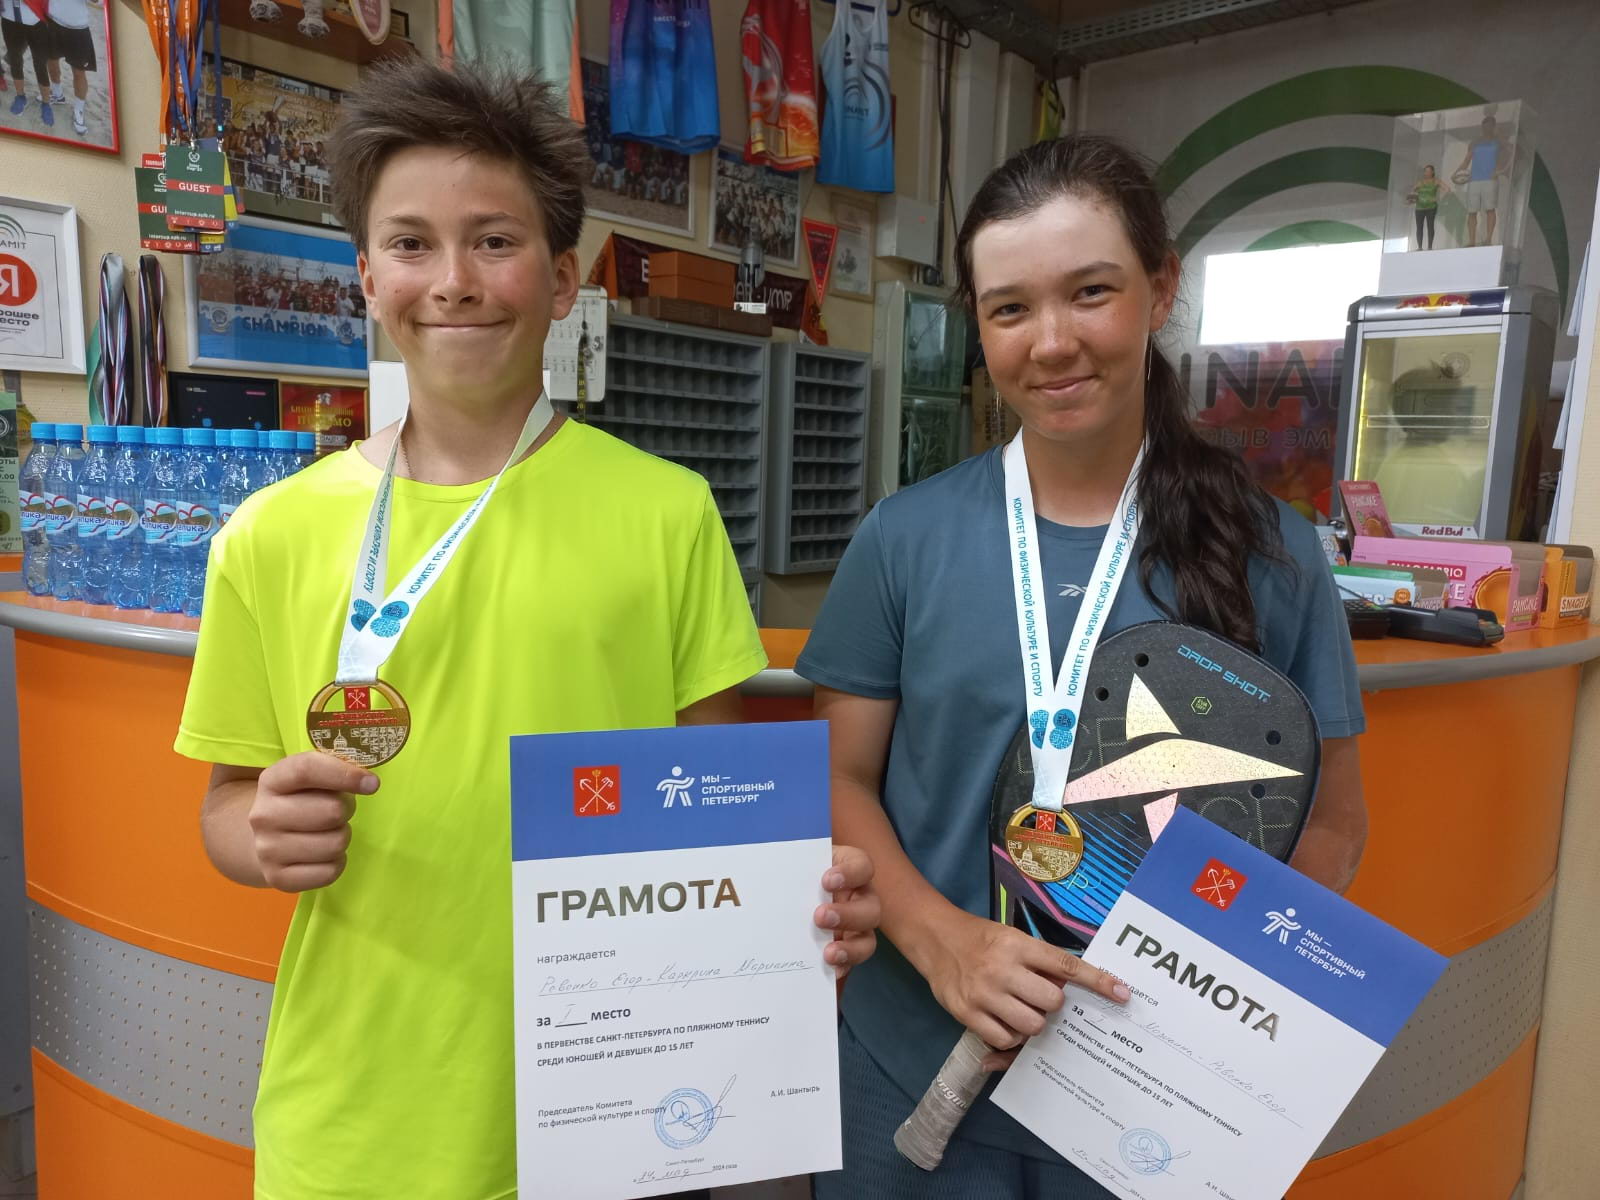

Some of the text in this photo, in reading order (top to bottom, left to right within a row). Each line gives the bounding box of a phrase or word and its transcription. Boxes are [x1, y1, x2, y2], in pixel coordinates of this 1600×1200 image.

[178, 182, 211, 193] GUEST
[0, 240, 27, 250] AMIT
[0, 310, 40, 320] ошее
[0, 317, 30, 326] есто
[242, 315, 329, 337] CHAMPION
[1180, 347, 1345, 410] INA
[1284, 425, 1332, 449] ЭМ
[363, 563, 376, 593] СПОРТУ
[406, 562, 438, 594] КОМИТЕТ
[432, 550, 446, 561] ПО
[1012, 497, 1043, 697] КОМИТЕТ ПО ФИЗИЧЕСКОЙ КУЛЬТУРЕ И СПОРТУ
[1066, 653, 1085, 696] КОМИТЕТ
[1079, 637, 1090, 653] ПО
[1087, 581, 1112, 637] ФИЗИЧЕСКОЙ
[1107, 540, 1126, 579] КУЛЬТУРЕ
[1177, 644, 1271, 701] DROP SHOT
[701, 775, 720, 784] МЫ
[701, 780, 775, 795] СПОРТИВНЫЙ
[702, 794, 760, 806] ПЕТЕРБУРГ
[536, 877, 742, 923] ГРАМОТА
[1306, 928, 1324, 944] МЫ
[537, 949, 616, 965] награждается
[1294, 944, 1347, 979] ПЕТЕРБУРГ
[1300, 937, 1367, 980] СПОРТИВНЫЙ
[1115, 923, 1282, 1043] ГРАМОТА
[536, 1016, 551, 1027] за
[591, 1007, 632, 1022] место
[1072, 1005, 1085, 1017] за
[1111, 1029, 1144, 1054] место
[537, 1016, 770, 1050] В ПЕРВЕНСТВЕ САНКТ-ПЕТЕРБУРГА ПО ПЛЯЖНОМУ ТЕННИСУ
[537, 1041, 695, 1067] СРЕДИ ЮНОШЕЙ И ДЕВУШЕК ДО 15 ЛЕТ
[1038, 1056, 1106, 1108] Председатель Комитета
[1056, 1028, 1174, 1109] СРЕДИ ЮНОШЕЙ И ДЕВУШЕК ДО 15 ЛЕТ
[1067, 1023, 1105, 1050] ПЕРВЕНСТВЕ
[1105, 1048, 1163, 1088] САНКТ-ПЕТЕРБУРГА
[1164, 1084, 1175, 1095] ПО
[1174, 1091, 1213, 1119] ПЛЯЖНОМУ
[1212, 1114, 1243, 1137] ТЕННИСУ
[770, 1085, 821, 1098] А.И. Шантырь
[1033, 1062, 1041, 1071] по
[1041, 1068, 1075, 1095] физической
[1074, 1093, 1101, 1114] культуре
[1105, 1114, 1126, 1131] спорту
[538, 1099, 633, 1117] Председатель Комитета
[538, 1121, 548, 1129] по
[550, 1113, 597, 1128] физической
[598, 1109, 633, 1121] культуре
[641, 1106, 666, 1116] спорту
